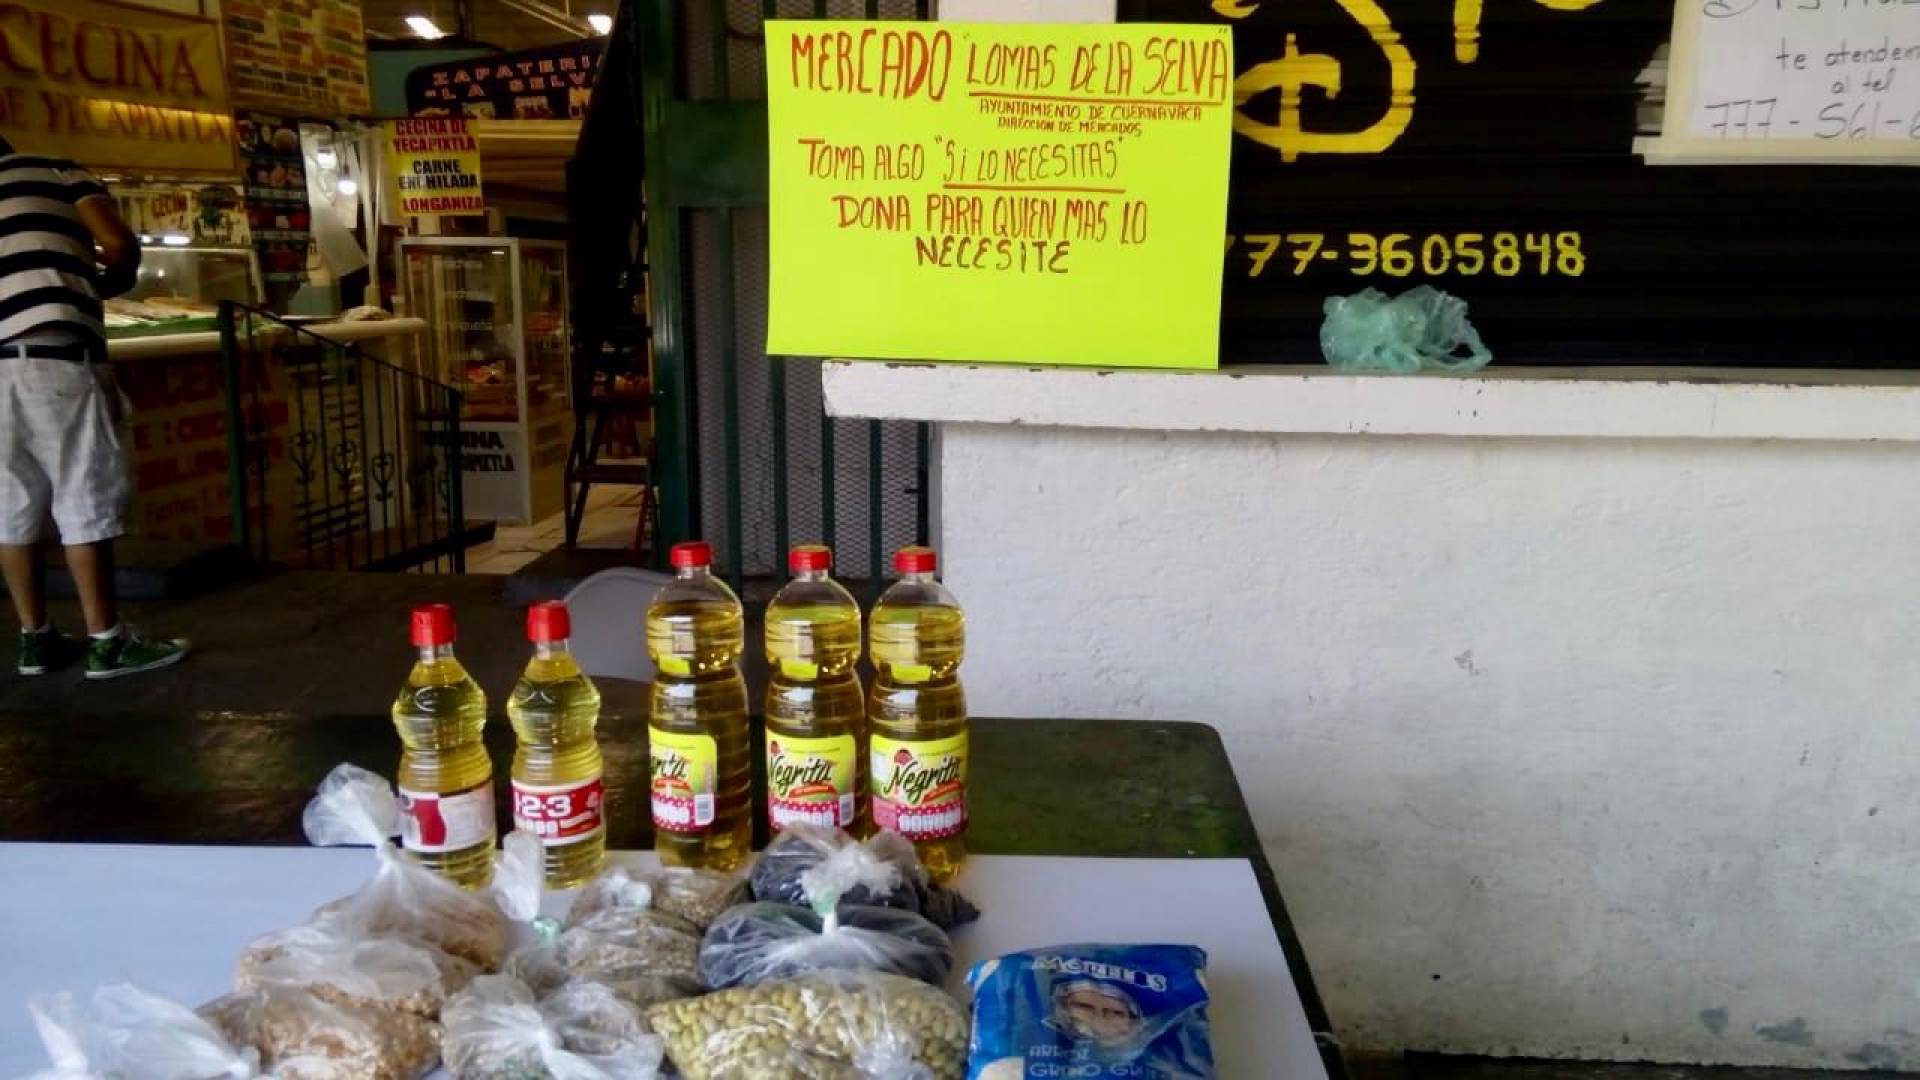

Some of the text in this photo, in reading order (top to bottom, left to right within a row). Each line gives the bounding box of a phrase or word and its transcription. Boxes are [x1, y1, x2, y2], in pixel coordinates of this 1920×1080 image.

[0, 2, 207, 98] CECINA
[791, 27, 953, 102] MERCADO
[1775, 35, 1808, 71] te
[431, 52, 604, 88] ZAPATERI
[508, 70, 600, 93] SELV
[1862, 66, 1896, 92] tel
[395, 119, 470, 135] CECINA DE
[980, 98, 1203, 121] AYUNTAMIENTO DE CUERNAVACA
[997, 116, 1142, 137] DIRECCION DE MERCADOS
[412, 158, 461, 175] CARNE
[797, 137, 866, 181] TOMA
[873, 142, 926, 183] ALGO
[978, 148, 1000, 182] LO
[402, 197, 482, 213] LONGANIZA
[831, 192, 1148, 246] DONA PARA QUIEN MAS LO
[1224, 230, 1587, 278] 77-3605848
[883, 753, 962, 805] Negrita
